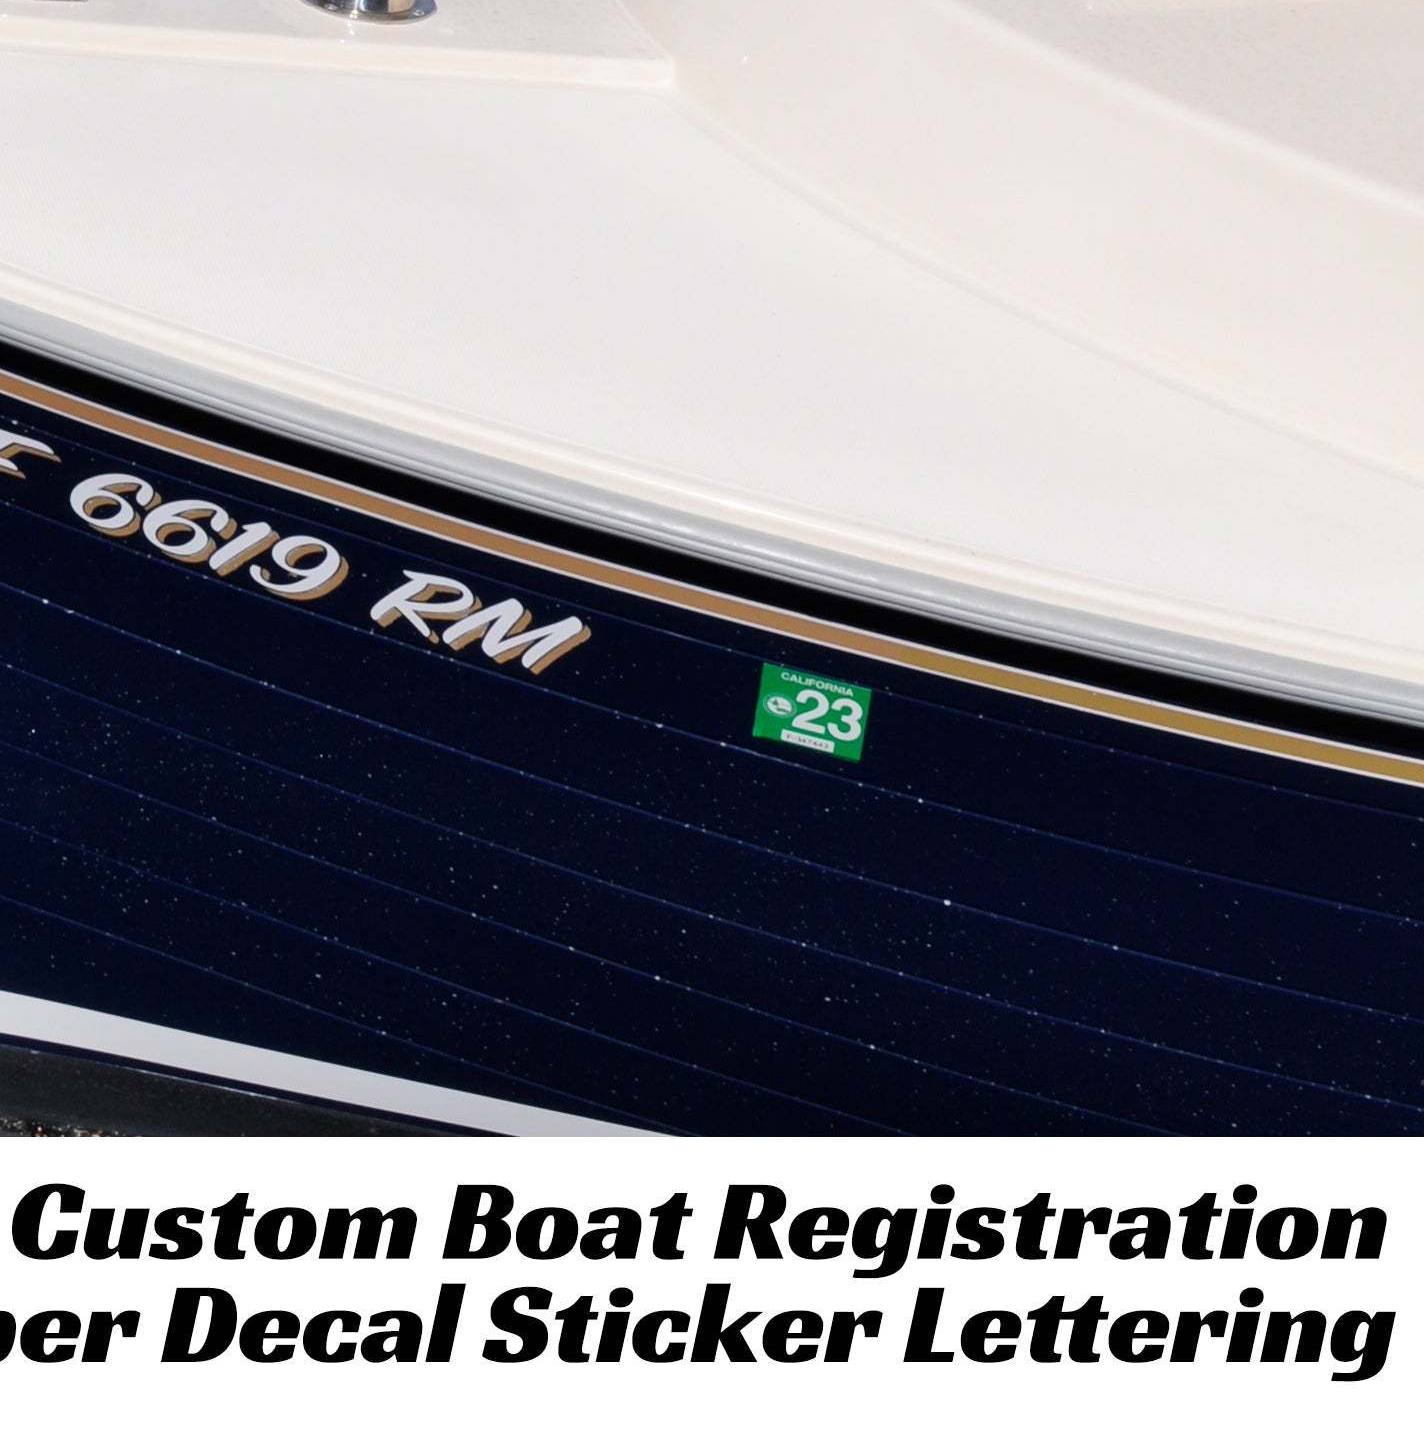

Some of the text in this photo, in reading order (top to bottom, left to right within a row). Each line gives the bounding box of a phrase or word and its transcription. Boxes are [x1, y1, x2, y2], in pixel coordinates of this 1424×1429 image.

[69, 472, 350, 601] 6619
[369, 568, 592, 676] RM
[780, 671, 854, 697] CALIFORNIA
[791, 688, 864, 742] 23
